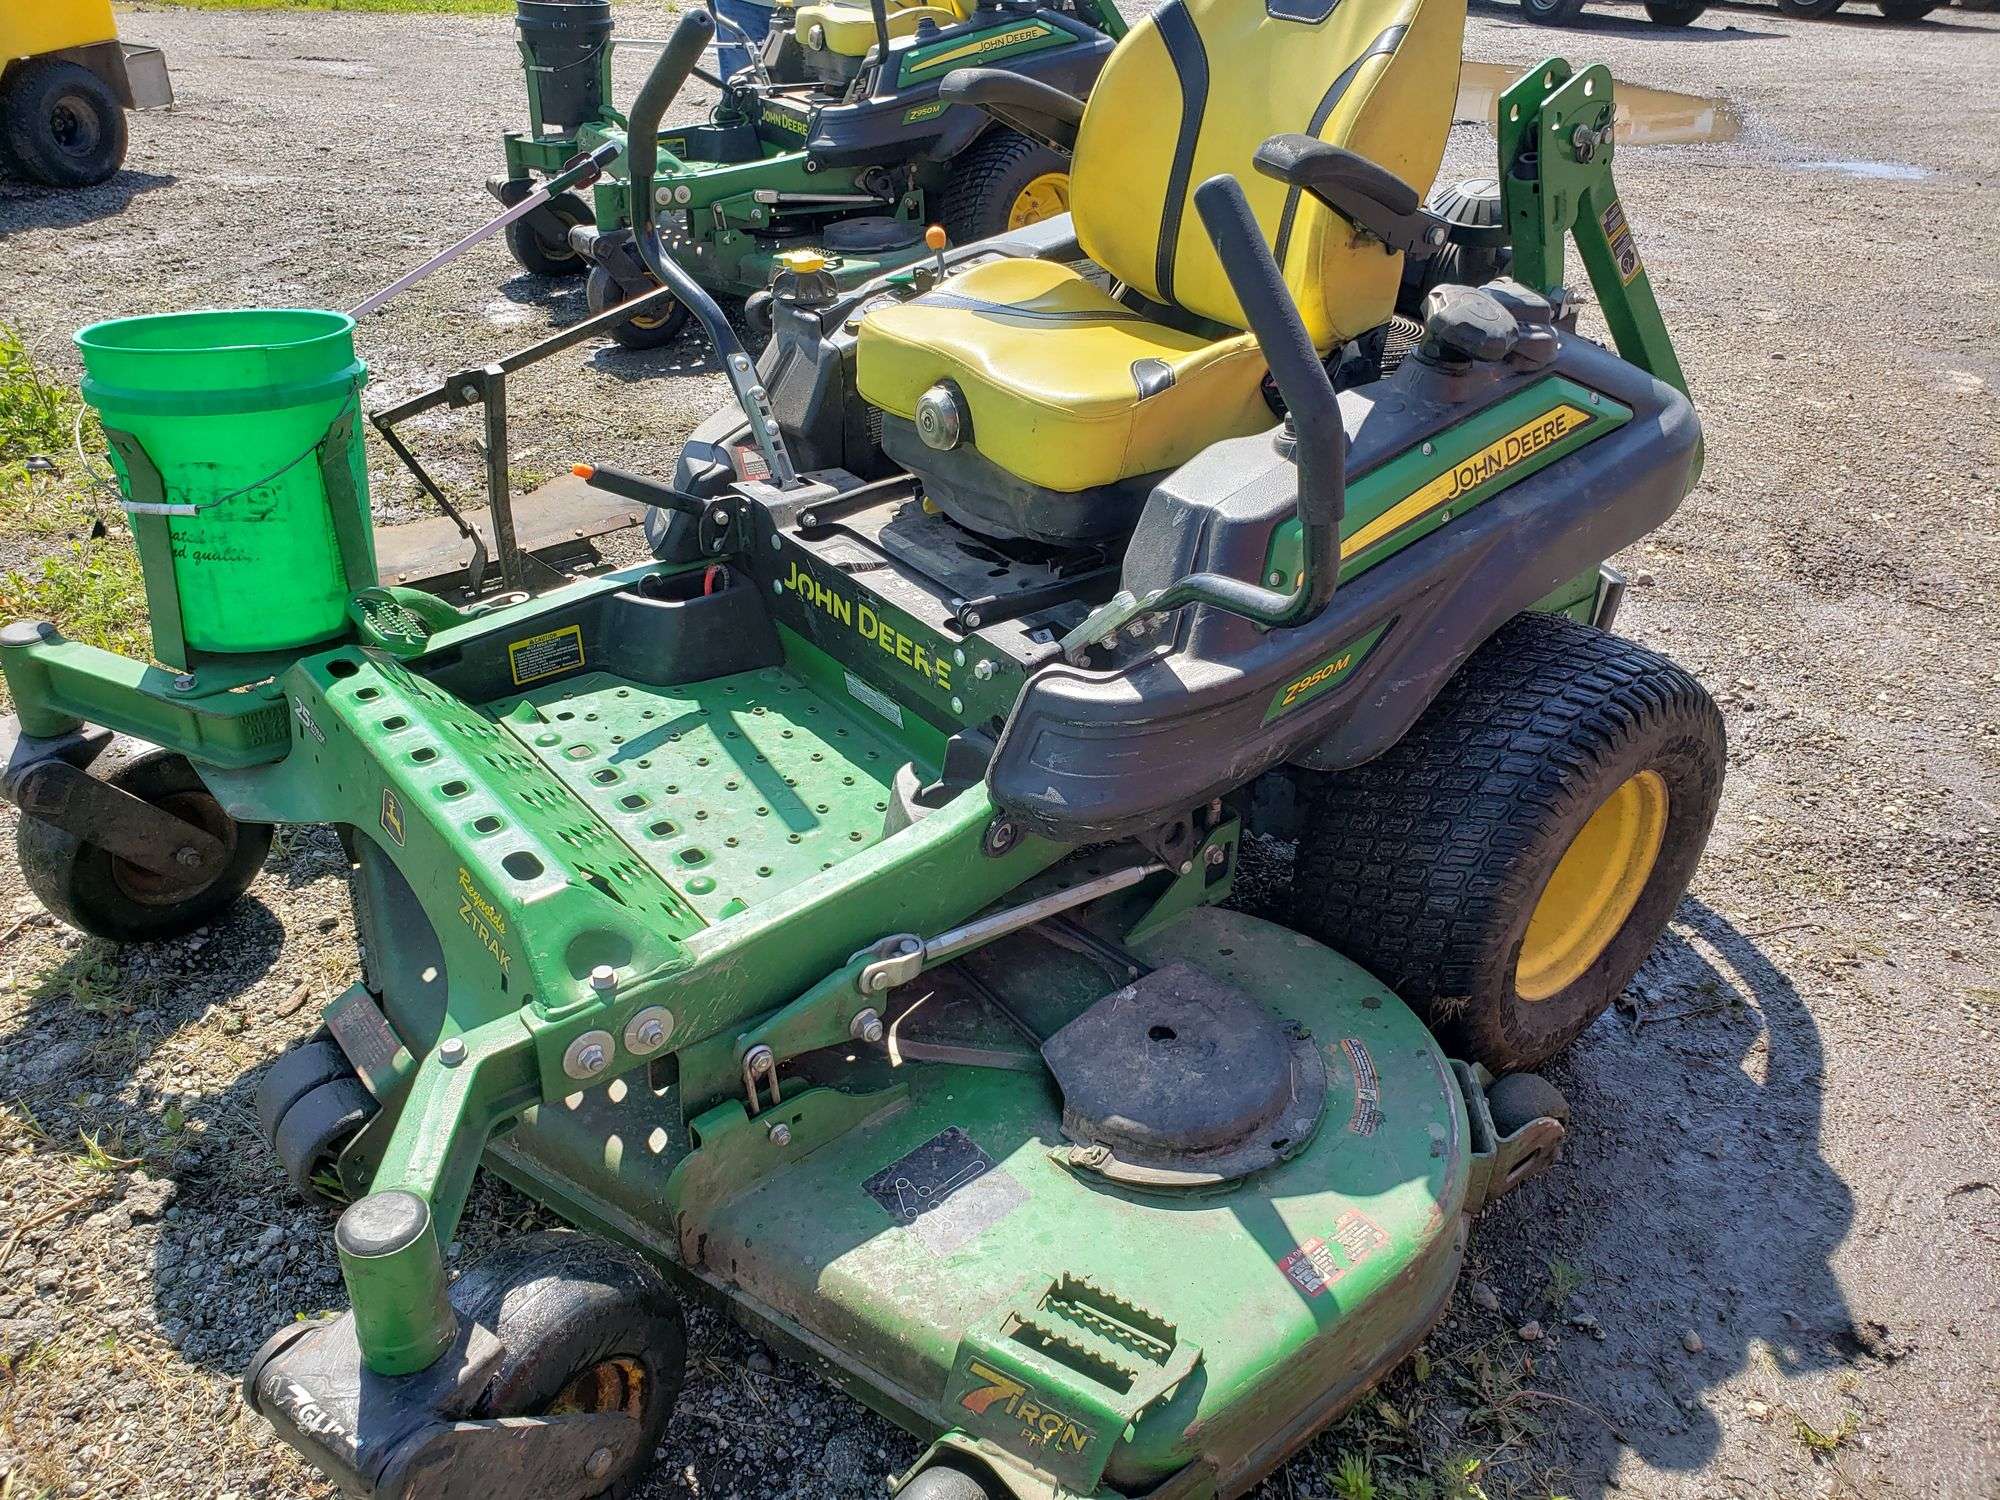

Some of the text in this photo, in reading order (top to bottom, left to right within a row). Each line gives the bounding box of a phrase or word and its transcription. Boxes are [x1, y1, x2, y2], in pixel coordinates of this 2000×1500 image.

[978, 29, 1038, 52] JOHN DEERE
[761, 106, 808, 136] JOHN DEERE
[910, 105, 941, 120] Z950M
[1448, 413, 1568, 497] JOHN DEERE
[784, 561, 951, 691] JOHN DEERE
[1280, 653, 1351, 707] Z950M
[459, 867, 506, 936] Reynolds
[459, 895, 511, 973] ZTRAK
